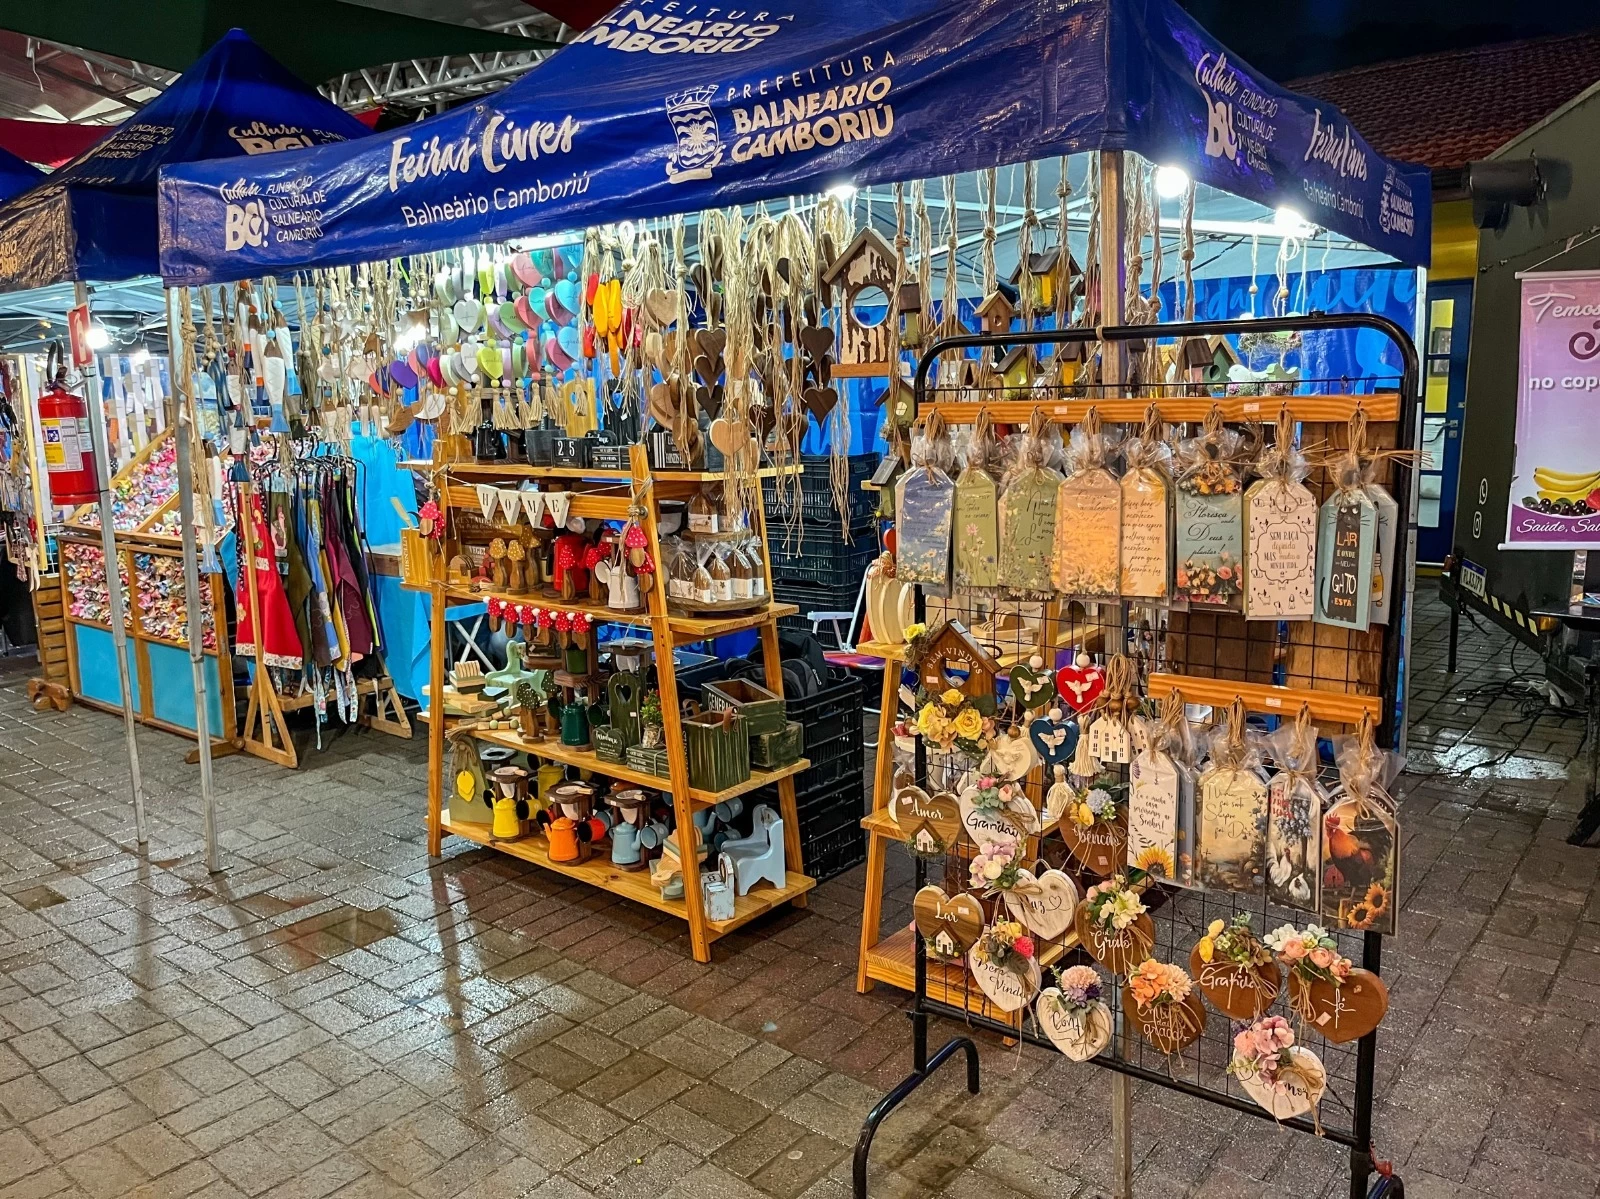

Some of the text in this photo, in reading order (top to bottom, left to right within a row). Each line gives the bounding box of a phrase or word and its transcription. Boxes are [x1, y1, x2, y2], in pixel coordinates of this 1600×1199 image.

[727, 51, 895, 102] PREFEITURA
[1196, 52, 1238, 97] Cultura
[732, 76, 892, 134] BALNEÁRIO
[1239, 89, 1278, 118] FUNDAÇÃO
[228, 121, 303, 139] Cultura
[731, 103, 894, 162] CAMBORIÚ
[1304, 109, 1343, 169] Feiras
[389, 115, 580, 192] Feiras Livres
[220, 177, 262, 204] Cultura
[266, 176, 313, 195] FUNDAÇÃO
[269, 190, 327, 210] CULTURAL DE
[401, 171, 590, 228] Balneário Camboriú
[1304, 179, 1364, 218] Balneário Camboriú
[272, 209, 323, 226] BALNEÁRIO
[1528, 376, 1600, 391] no cop
[1186, 522, 1223, 541] Deus
[1516, 518, 1568, 534] Saúde,
[1336, 531, 1358, 548] LAR
[1331, 572, 1357, 595] GATO
[909, 799, 944, 821] Amor
[934, 901, 959, 924] Lar
